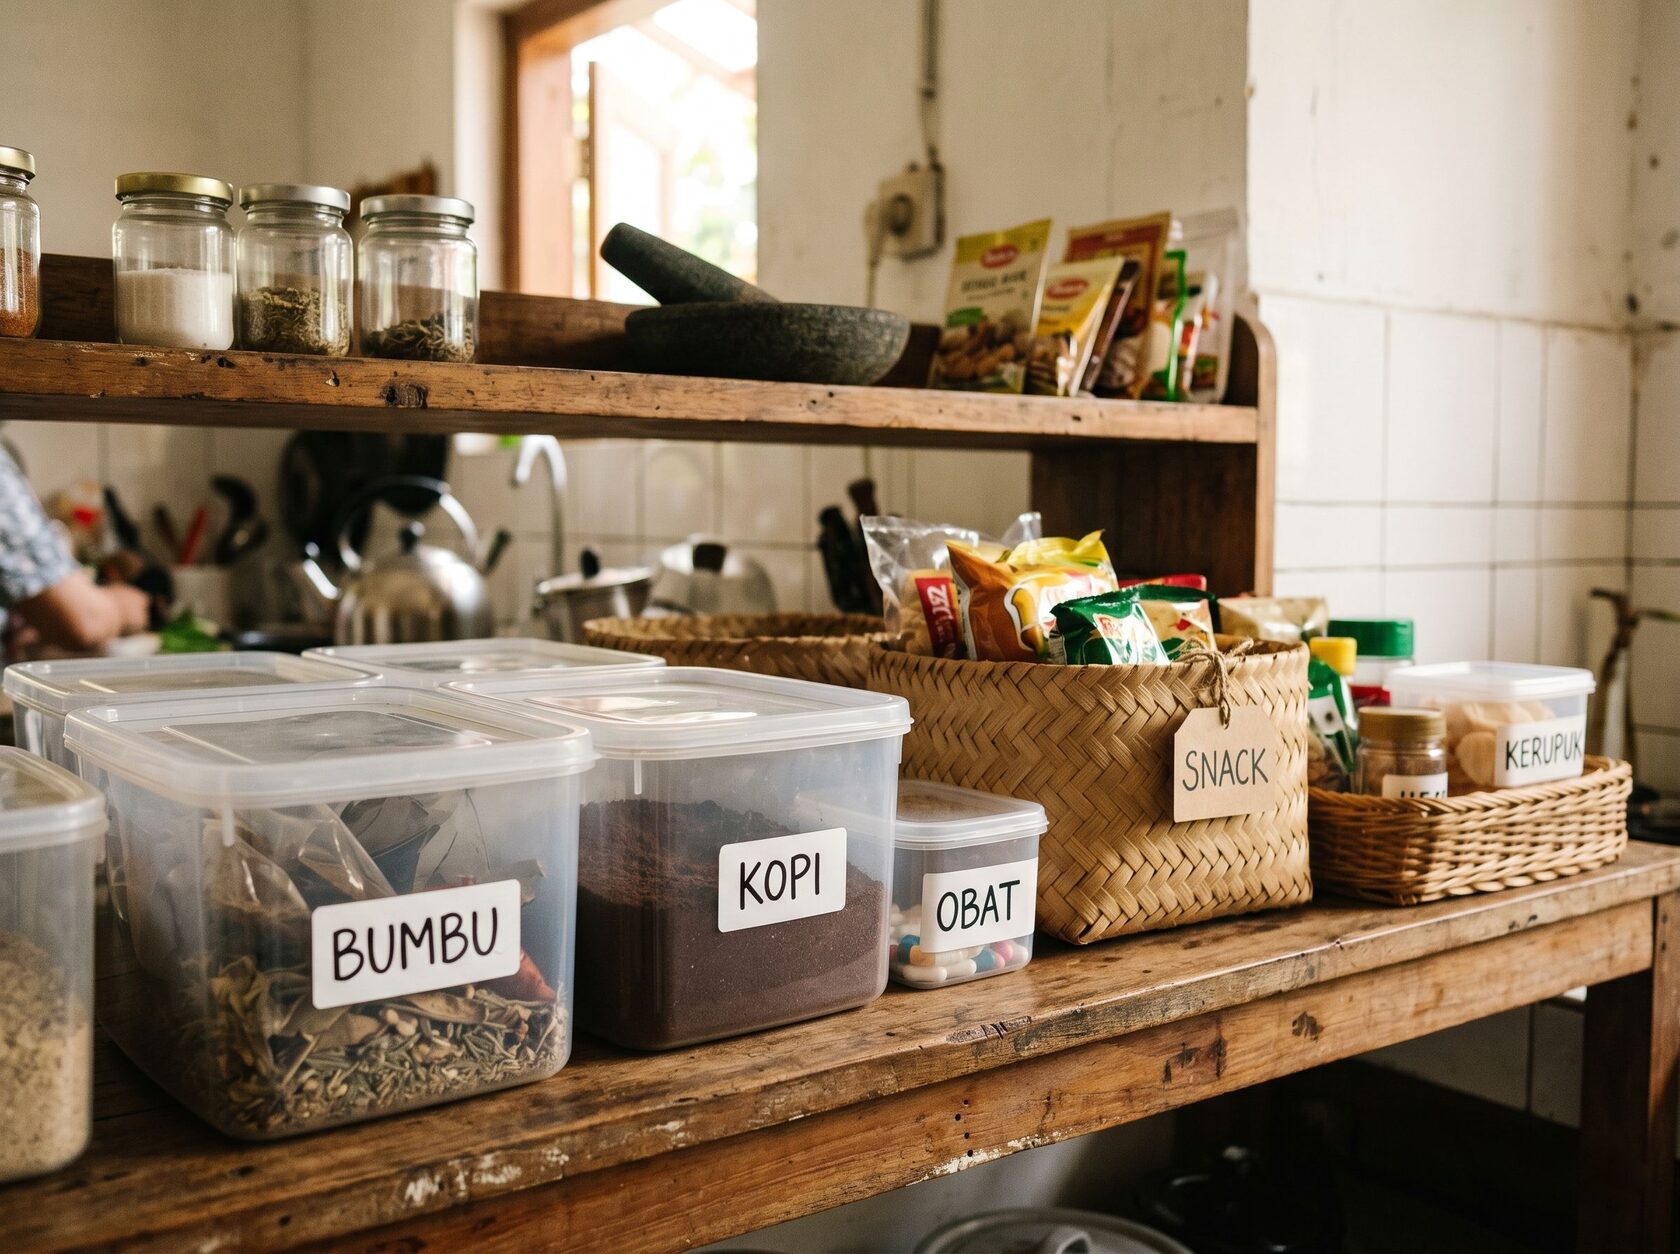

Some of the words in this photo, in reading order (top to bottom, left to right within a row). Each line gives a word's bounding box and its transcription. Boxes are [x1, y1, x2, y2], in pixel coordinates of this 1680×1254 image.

[1182, 748, 1269, 791] SNACK
[1505, 730, 1583, 771] KERUPUK
[739, 852, 820, 910] KOPI
[936, 879, 1021, 932] OBAT
[333, 906, 498, 981] BUMBU
